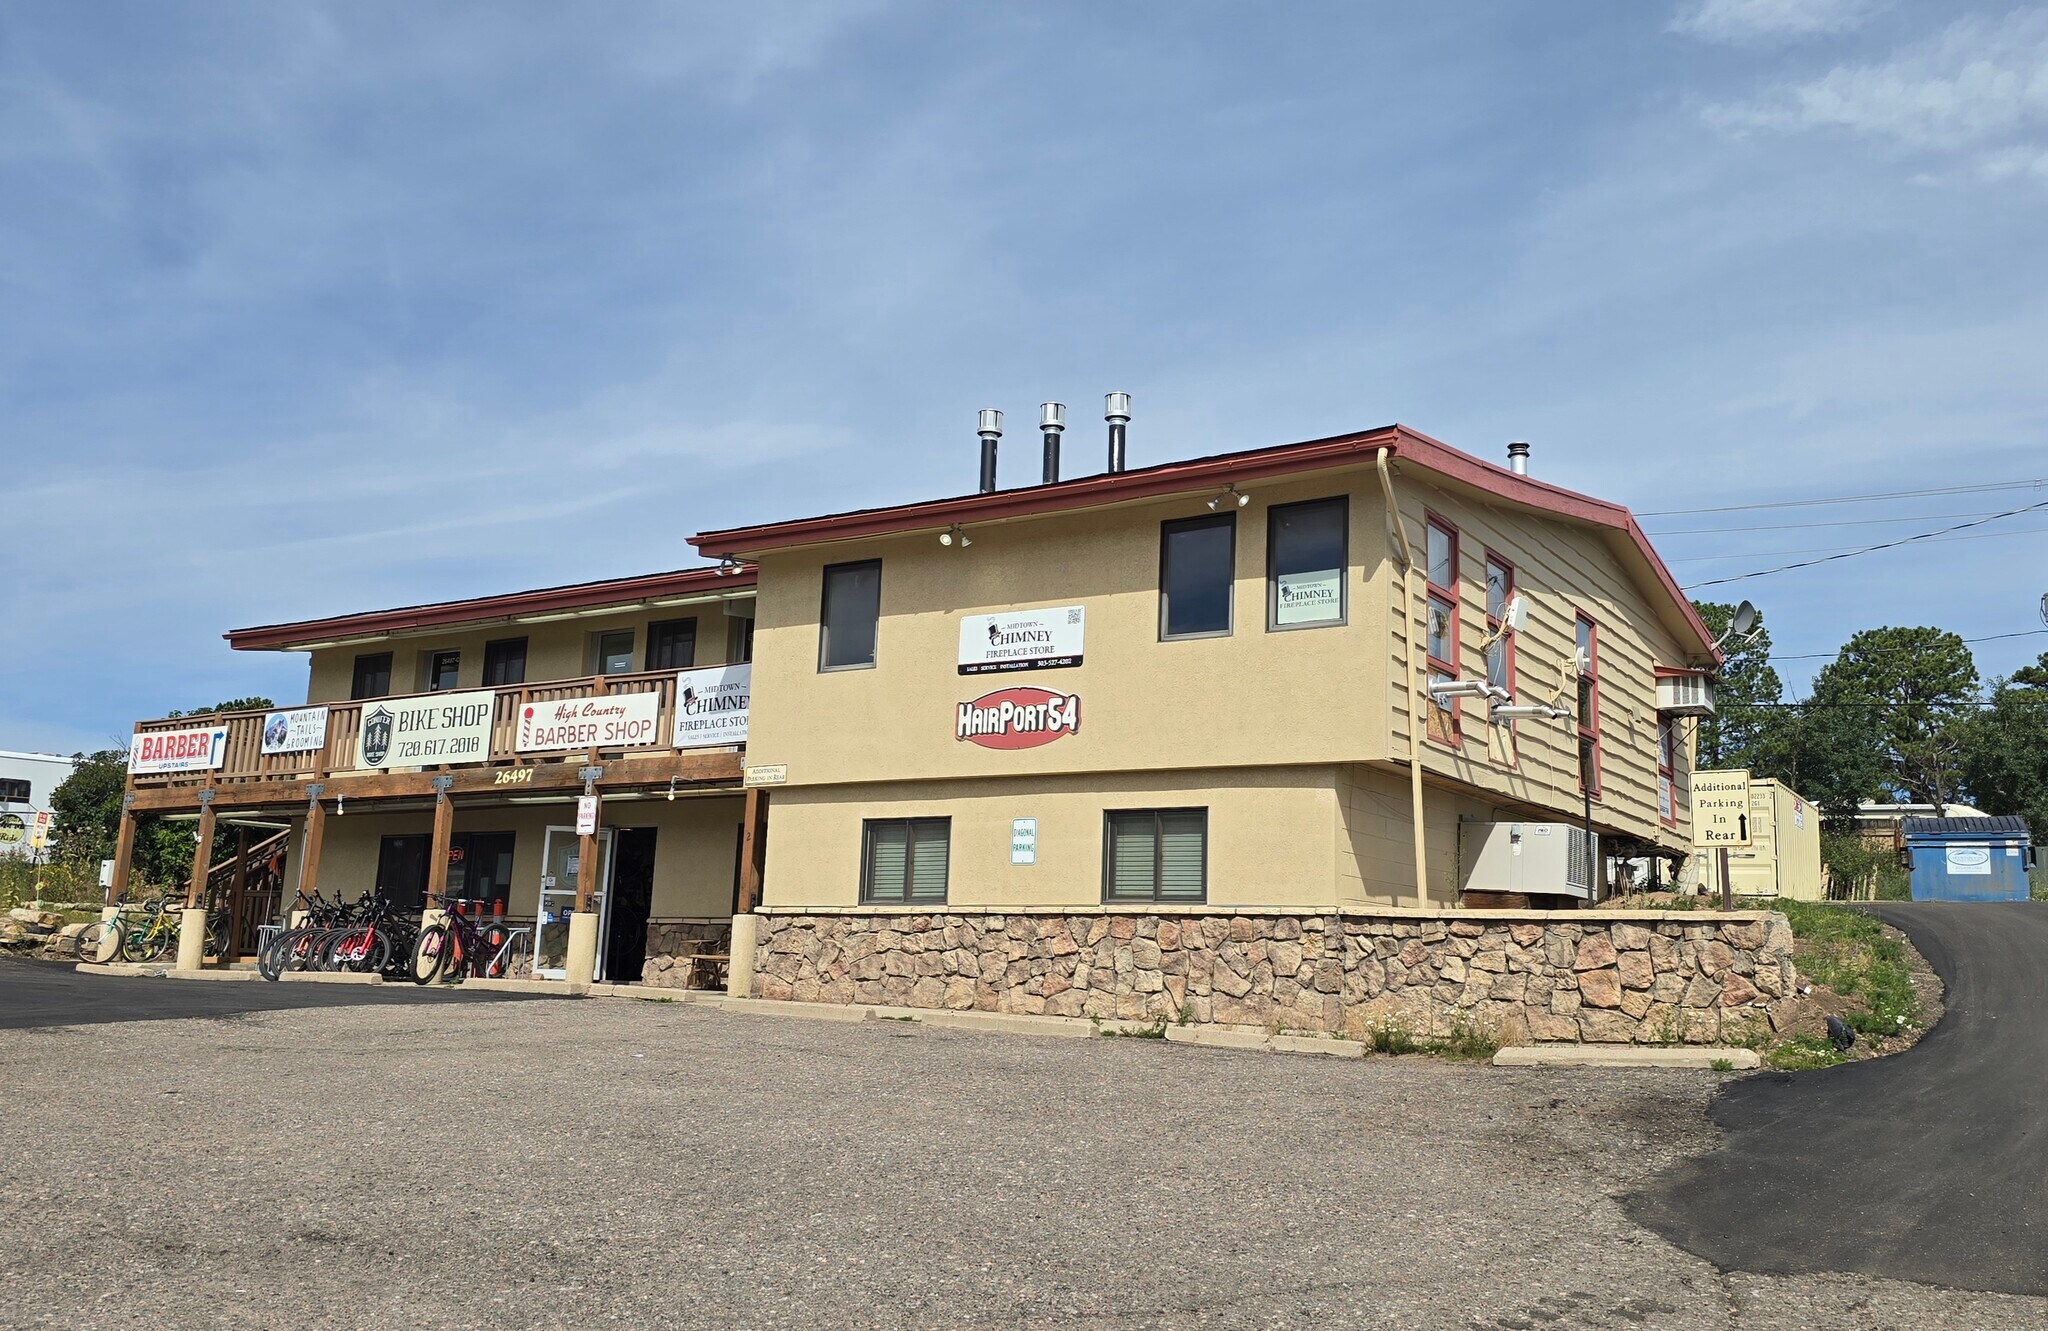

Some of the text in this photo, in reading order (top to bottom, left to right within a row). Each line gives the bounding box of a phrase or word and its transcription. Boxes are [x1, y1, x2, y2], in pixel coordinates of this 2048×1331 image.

[1284, 590, 1333, 602] CHIMNEY
[1280, 600, 1316, 608] FIREPLACE
[1007, 621, 1038, 629] MIDTOWN
[991, 630, 1053, 646] CHIMNEY
[986, 646, 1055, 658] FIREPLACE STORE
[704, 683, 740, 694] MIDTOWN
[686, 696, 749, 716] CHIMNE
[290, 710, 325, 723] MOUNTAIN
[398, 704, 488, 732] BIKE SHOP
[554, 702, 626, 724] High Country
[680, 716, 748, 732] FIREPLACE STO
[535, 720, 652, 746] BARBER SHOP
[140, 732, 210, 761] BARBER
[286, 735, 322, 748] GROOMING
[398, 737, 480, 758] 720.617.2018
[158, 761, 188, 769] UPSTAIRS
[494, 769, 534, 784] 26497
[1693, 782, 1746, 792] Additional
[1700, 799, 1743, 809] Parking
[1713, 814, 1726, 824] In
[1706, 830, 1736, 840] Rear
[448, 850, 464, 860] PEN
